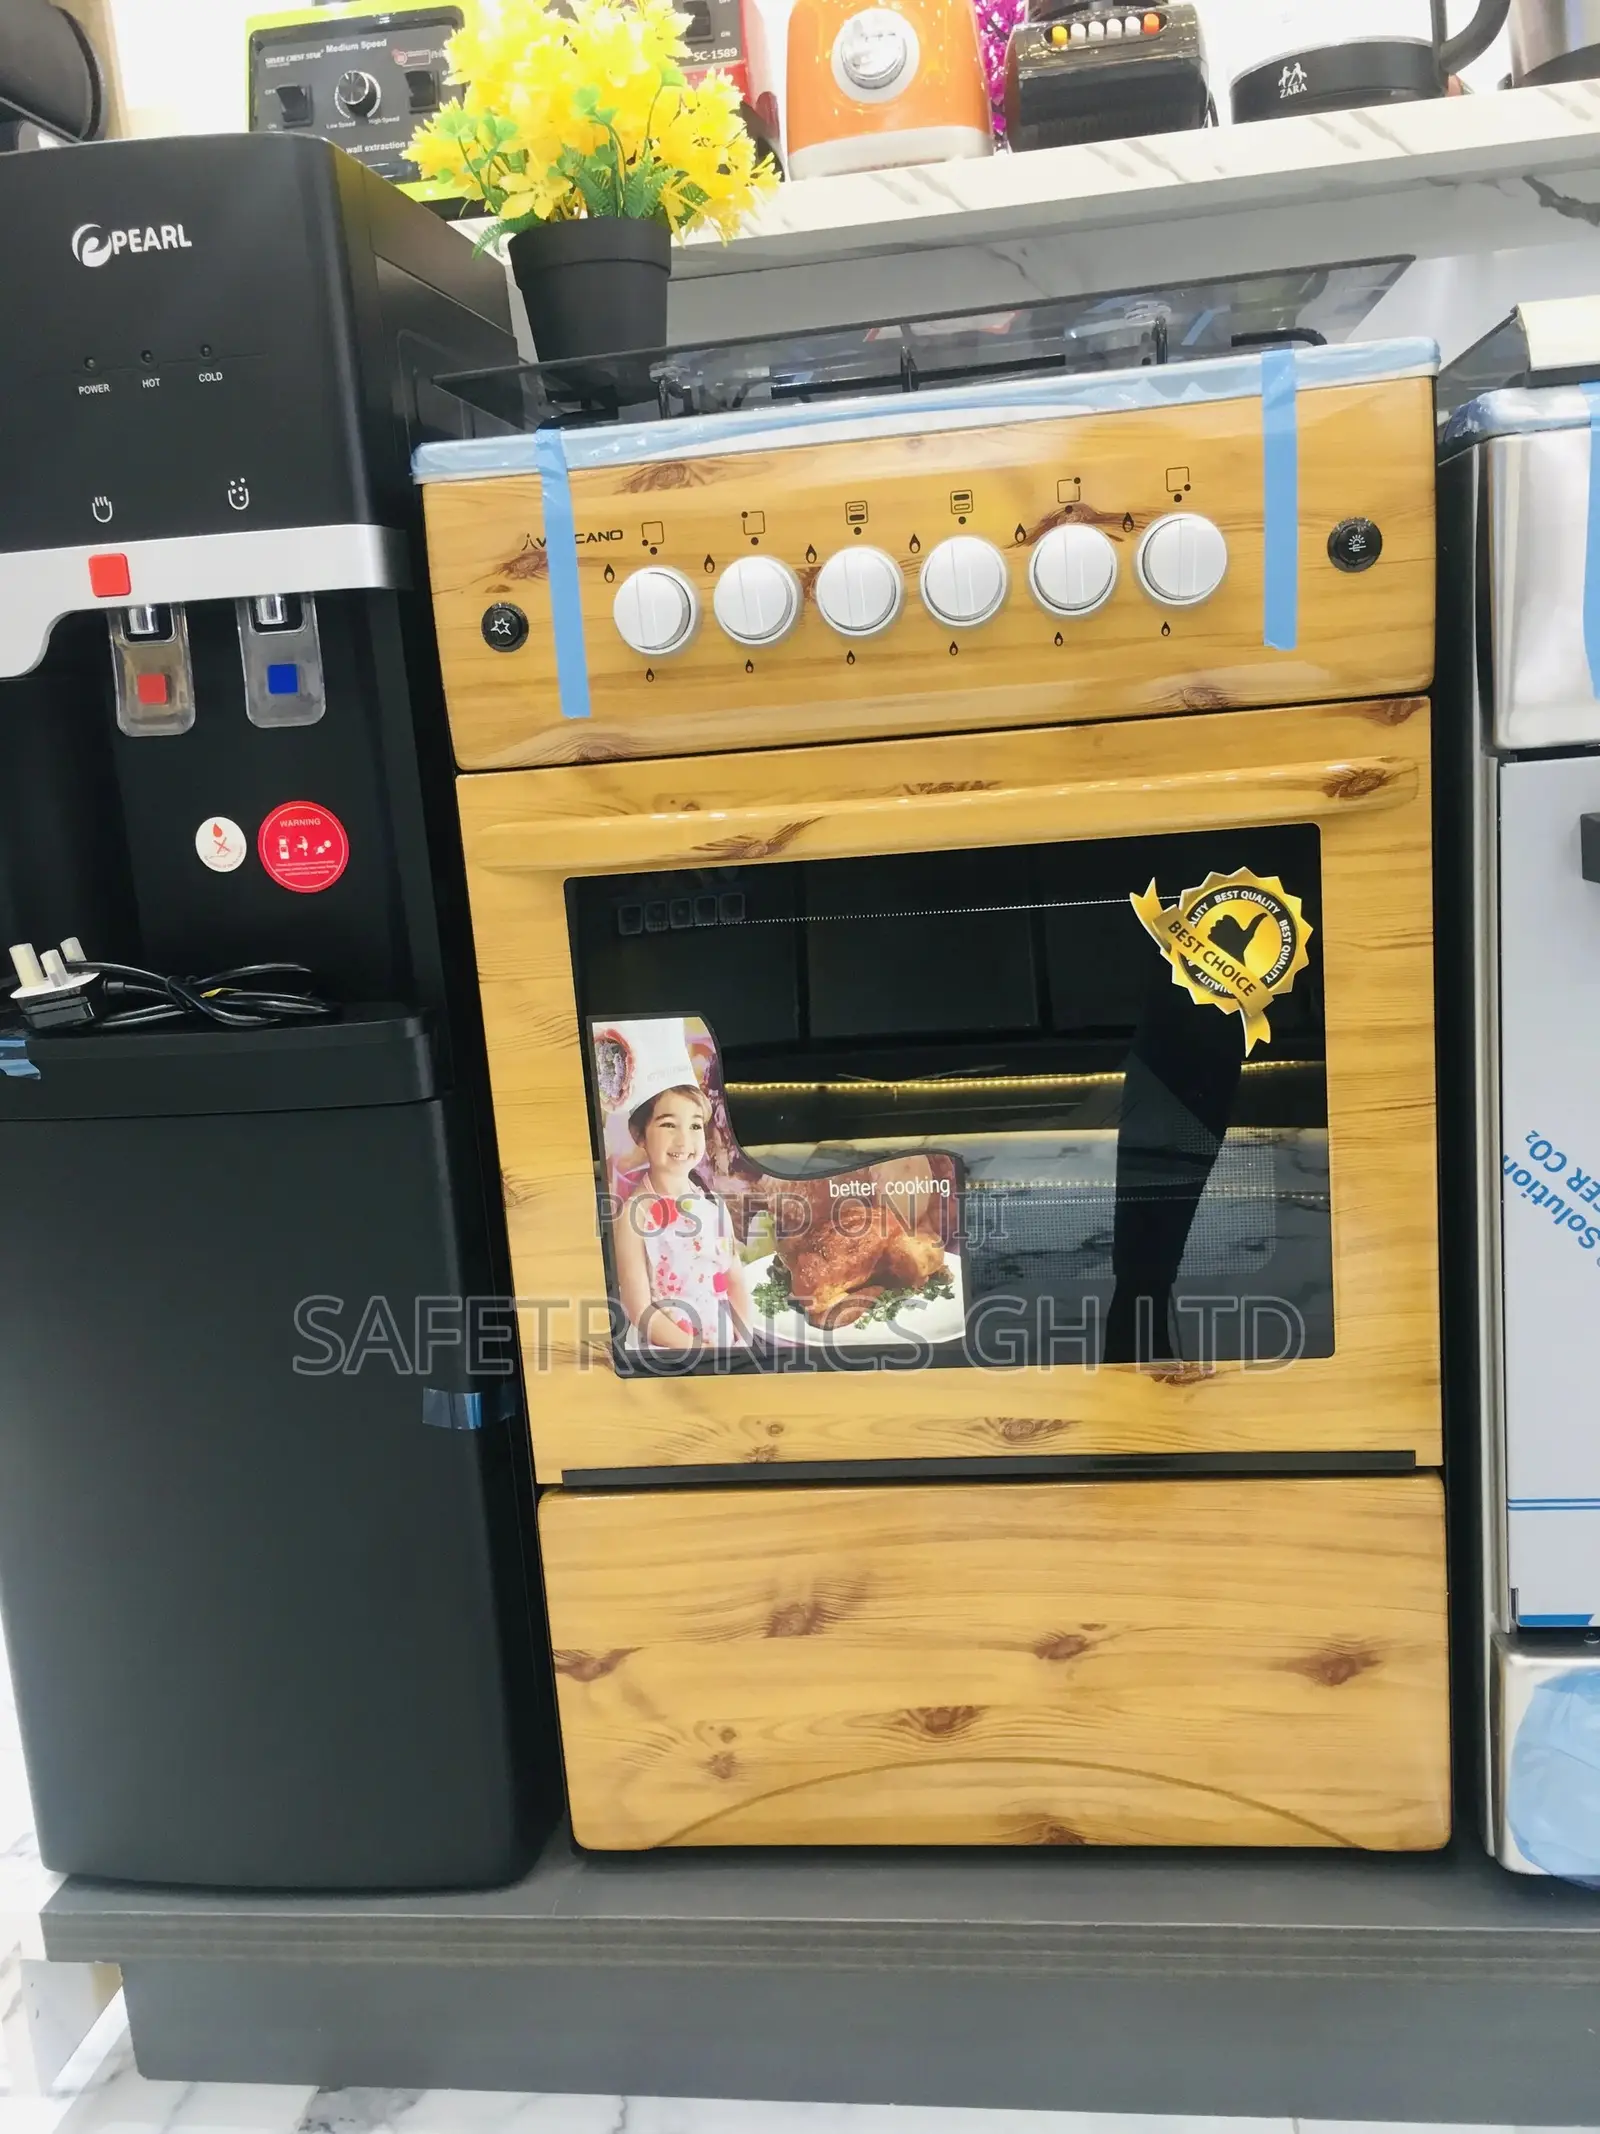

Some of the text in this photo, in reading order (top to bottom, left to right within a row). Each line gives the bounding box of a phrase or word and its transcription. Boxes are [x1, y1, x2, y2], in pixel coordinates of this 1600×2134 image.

[326, 39, 387, 53] Medium Speed
[693, 47, 738, 62] SC-1589
[1279, 83, 1308, 99] ZARA
[346, 145, 363, 154] wall
[365, 142, 406, 152] extraction
[111, 224, 193, 255] PEARL
[142, 378, 161, 389] HOT
[198, 372, 223, 382] COLD
[78, 383, 111, 395] POWER
[535, 529, 624, 548] VCANO
[279, 818, 321, 828] WARNING
[1214, 890, 1281, 915] BEST QUALITY
[1167, 920, 1257, 997] BEST CHOICE
[1265, 919, 1292, 984] BEST QUALITY
[829, 1178, 950, 1197] better cooking
[1503, 1154, 1600, 1250] Solution
